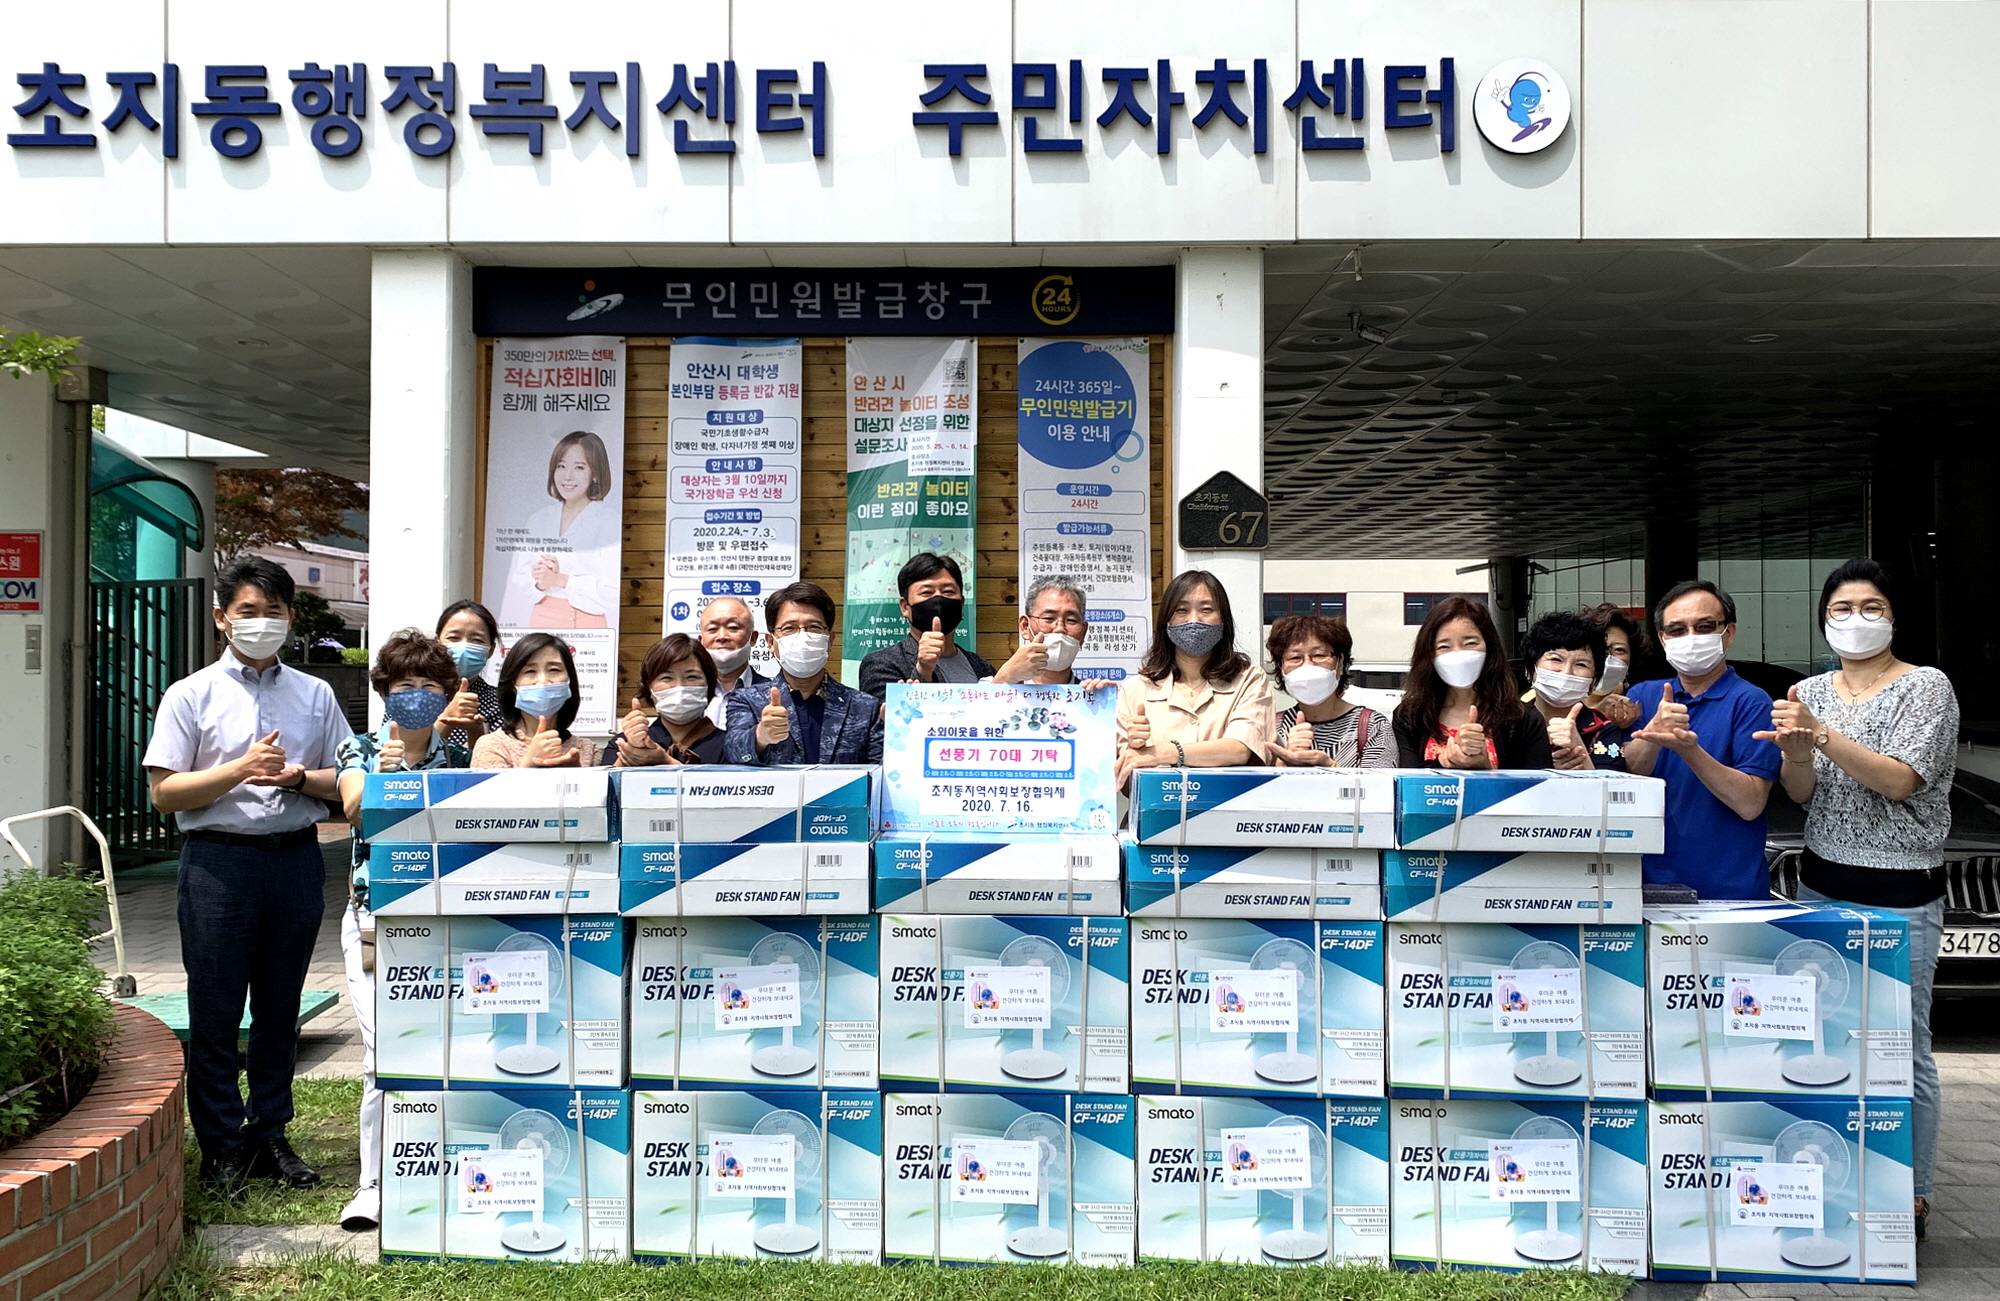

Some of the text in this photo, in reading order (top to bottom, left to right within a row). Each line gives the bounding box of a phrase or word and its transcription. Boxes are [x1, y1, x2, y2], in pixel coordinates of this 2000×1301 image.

[5, 57, 1456, 159] 초지동행정복지센터 주민자치센터
[1042, 286, 1072, 304] 24
[661, 281, 992, 321] 무인민원발급창구
[1041, 306, 1072, 314] HOURS
[504, 349, 616, 363] 350만의 가치있는 선택,
[687, 363, 779, 380] 안산시 대학생
[504, 367, 616, 388] 적십자회비에
[671, 383, 799, 400] 본인부담 등록금 반값 지원
[1035, 380, 1121, 394] 24시간 365일~
[503, 393, 610, 412] 함께 해주세요
[854, 394, 970, 412] 반려견 놀이터 조성
[1020, 398, 1132, 419] 무인민원발급기
[854, 414, 970, 432] 대상지 선정을 위한
[701, 428, 769, 437] 국민기초생활수급자
[1048, 424, 1110, 442] 이용 안내
[674, 442, 697, 450] 장애인
[701, 442, 718, 451] 학생,
[721, 441, 758, 450] 다자녀가정
[779, 441, 794, 449] 이상
[855, 438, 907, 454] 설문조사
[681, 475, 787, 486] 대상자는 3월 10일까지
[685, 488, 782, 499] 국가장학금 우선 신청
[878, 481, 969, 498] 반려견 놀이터
[1070, 485, 1099, 494] 운영시간
[1195, 493, 1229, 502] 초지동로
[858, 501, 969, 519] 이런 점이 좋아요
[1071, 500, 1098, 509] 24시간
[706, 512, 760, 521] 접수기간 및 방법
[1063, 524, 1107, 533] 발급가능서류
[1219, 512, 1263, 544] 67
[697, 540, 769, 551] 방문 및 우편접수
[711, 582, 752, 592] 접수 장소
[673, 606, 688, 616] 1차
[1105, 643, 1136, 651] 라성상가
[1096, 670, 1121, 679] 장애 문의
[927, 727, 1004, 737] 소외이웃을 위한
[939, 748, 1058, 762] 선풍기 70대 기탁
[383, 780, 422, 790] smato
[690, 785, 774, 796] DESK STAND FAN
[383, 793, 417, 801] CF-14DF
[931, 785, 1065, 798] 초지동지역사회보장협의체
[962, 801, 1033, 812] 2020. 7. 16.
[455, 818, 539, 830] DESK STAND FAN
[1236, 823, 1323, 834] DESK STAND FAN
[810, 825, 848, 835] smato
[1501, 827, 1591, 838] DESK STAND FAN
[391, 851, 430, 861] smato
[392, 864, 427, 872] CF-14DF
[465, 890, 550, 901] DESK STAND FAN
[715, 892, 801, 902] DESK STAND FAN
[386, 927, 431, 938] smato
[1321, 939, 1373, 950] CF-14DF
[386, 966, 431, 981] DESK
[892, 967, 936, 982] DESK
[389, 985, 444, 1000] STAND
[393, 1102, 437, 1114] smato
[644, 1103, 689, 1114] smato
[1073, 1113, 1125, 1124] CF-14DF
[1148, 1109, 1194, 1119] smato
[393, 1142, 438, 1157] DESK
[644, 1143, 690, 1158] DESK
[1149, 1149, 1194, 1164] DESK
[1661, 1154, 1706, 1169] DESK
